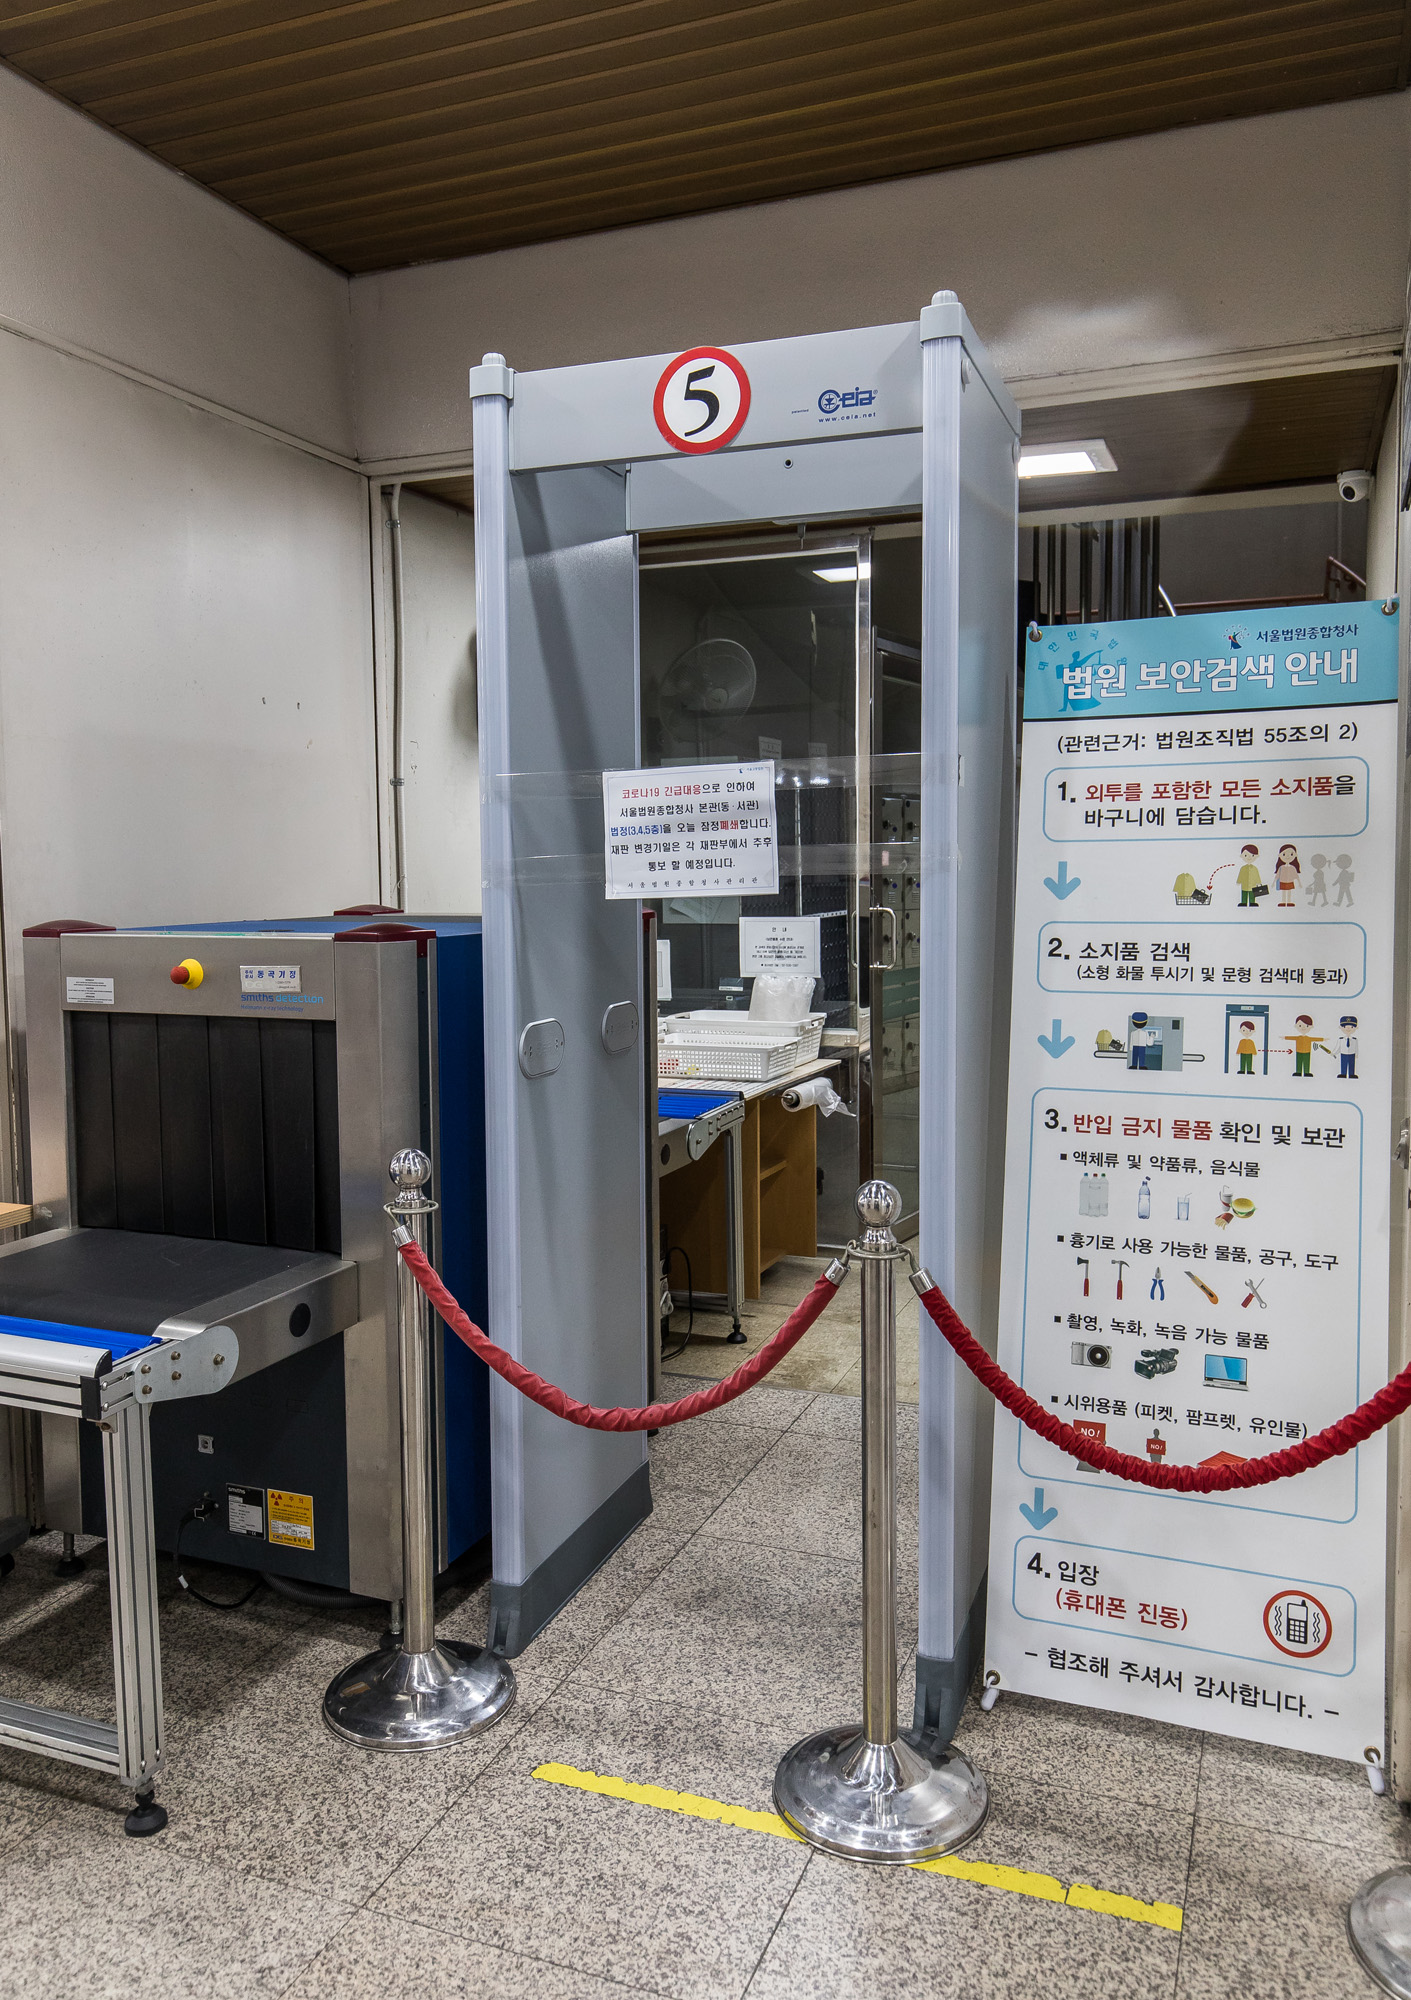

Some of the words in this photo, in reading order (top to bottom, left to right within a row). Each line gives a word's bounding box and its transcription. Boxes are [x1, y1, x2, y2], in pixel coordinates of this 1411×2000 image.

[684, 364, 721, 437] 5
[818, 411, 876, 422] www.ceia.net
[1256, 623, 1359, 643] 서울법원종합청사
[1063, 663, 1127, 700] 법원
[1135, 653, 1276, 694] 보안검색
[1285, 647, 1359, 687] 안내
[1057, 733, 1146, 754] (관련근거:
[1156, 727, 1254, 750] 법원조직법
[1264, 723, 1329, 744] 55조의
[1339, 721, 1359, 742] 2)
[622, 787, 660, 800] 코로나19
[664, 782, 721, 797] 긴급대응으로
[726, 780, 756, 793] 인하여
[1057, 781, 1077, 803] 1.
[1084, 781, 1143, 803] 외투를
[1152, 779, 1212, 801] 포함한
[1220, 777, 1262, 798] 모든
[1270, 774, 1356, 797] 소지품을
[619, 803, 694, 818] 서울법원종합청사
[1084, 807, 1166, 828] 바구니에
[1175, 804, 1267, 827] 담습니다.
[677, 822, 696, 833] 오늘
[700, 817, 772, 832] 잠정폐쇄합니다.
[611, 844, 629, 855] 재판
[634, 841, 681, 854] 변경기일은
[685, 840, 695, 851] 각
[700, 837, 748, 851] 재판부에서
[753, 836, 772, 848] 추후
[648, 860, 666, 872] 통보
[671, 859, 681, 870] 할
[685, 857, 736, 870] 예정입니다.
[1047, 937, 1070, 961] 2.
[1078, 941, 1141, 963] 소지품
[1149, 941, 1191, 963] 검색
[1077, 964, 1110, 981] (소형
[1115, 965, 1145, 982] 화물
[1150, 966, 1195, 983] 투시기
[1201, 967, 1216, 983] 및
[1221, 967, 1252, 984] 문형
[1259, 968, 1304, 985] 검색대
[1311, 968, 1348, 986] 통과)
[240, 993, 274, 1002] smiths
[275, 994, 324, 1004] detection
[1044, 1108, 1067, 1133] 3.
[1073, 1113, 1112, 1136] 반입
[1121, 1116, 1162, 1138] 금지
[1171, 1118, 1213, 1141] 물품
[1219, 1121, 1262, 1144] 확인
[1271, 1124, 1292, 1146] 및
[1301, 1126, 1345, 1149] 보관
[1072, 1150, 1120, 1168] 액체류
[1127, 1153, 1142, 1169] 및
[1149, 1154, 1203, 1175] 약품류,
[1210, 1157, 1261, 1177] 음식물
[1069, 1233, 1116, 1251] 흉기로
[1122, 1236, 1153, 1255] 사용
[1160, 1240, 1208, 1260] 가능한
[1214, 1244, 1252, 1265] 물품,
[1258, 1248, 1297, 1269] 공구,
[1304, 1252, 1339, 1271] 도구
[1066, 1313, 1104, 1333] 촬영,
[1110, 1317, 1147, 1338] 녹화,
[1154, 1321, 1187, 1341] 녹음
[1195, 1326, 1228, 1346] 가능
[1235, 1331, 1270, 1350] 물품
[1064, 1394, 1128, 1417] 시위용품
[1134, 1400, 1179, 1424] (피켓,
[1185, 1408, 1242, 1433] 팜프렛,
[1249, 1416, 1308, 1441] 유인물)
[1027, 1552, 1051, 1579] 4.
[1057, 1561, 1100, 1587] 입장
[1055, 1587, 1127, 1619] (휴대폰
[1137, 1602, 1189, 1631] 진동)
[1047, 1647, 1109, 1678] 협조해
[1118, 1660, 1184, 1692] 주셔서
[1193, 1674, 1314, 1719] 감사합니다.
